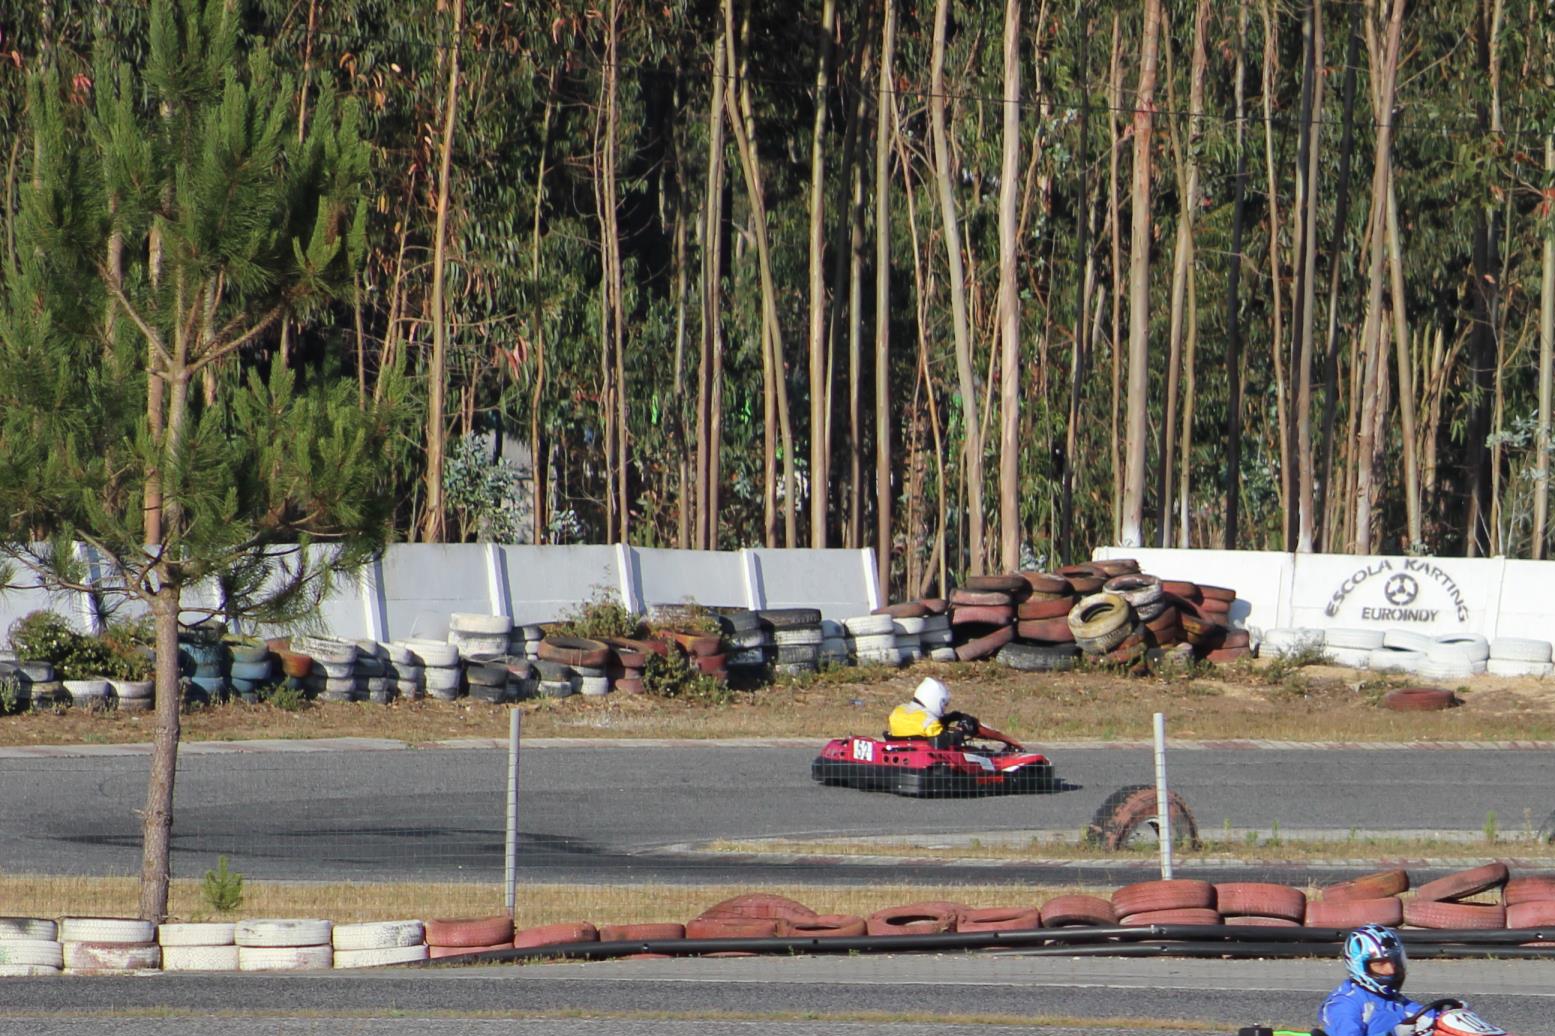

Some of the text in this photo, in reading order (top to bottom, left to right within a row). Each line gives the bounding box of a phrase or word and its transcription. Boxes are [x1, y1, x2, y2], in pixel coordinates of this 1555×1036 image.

[1325, 558, 1470, 622] ESCOLA KARTING
[1361, 606, 1439, 622] EUROINDY
